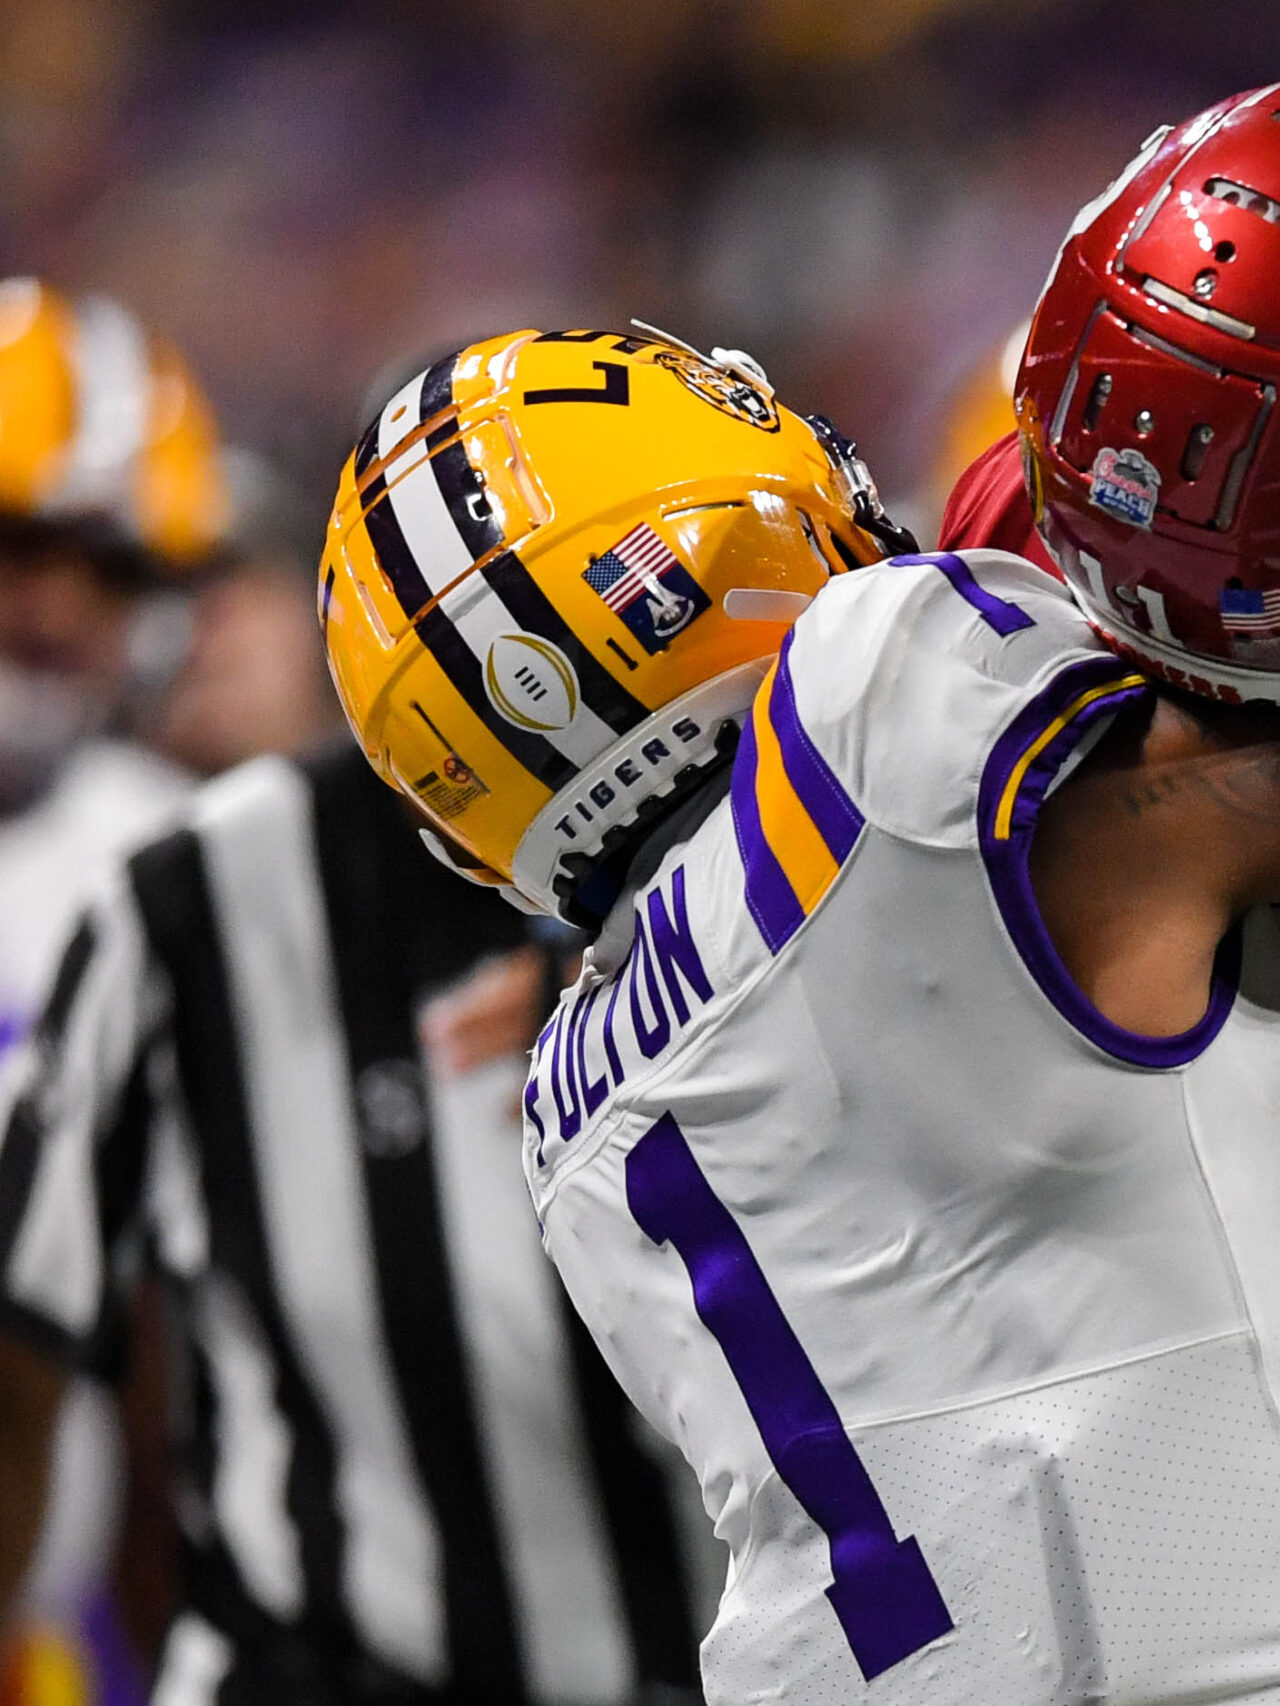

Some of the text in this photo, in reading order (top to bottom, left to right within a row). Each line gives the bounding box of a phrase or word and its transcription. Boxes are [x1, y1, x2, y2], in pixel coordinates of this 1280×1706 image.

[888, 552, 1038, 638] 1
[554, 717, 701, 840] TIGERS
[523, 863, 715, 1168] FULTON
[625, 1109, 955, 1682] 1
